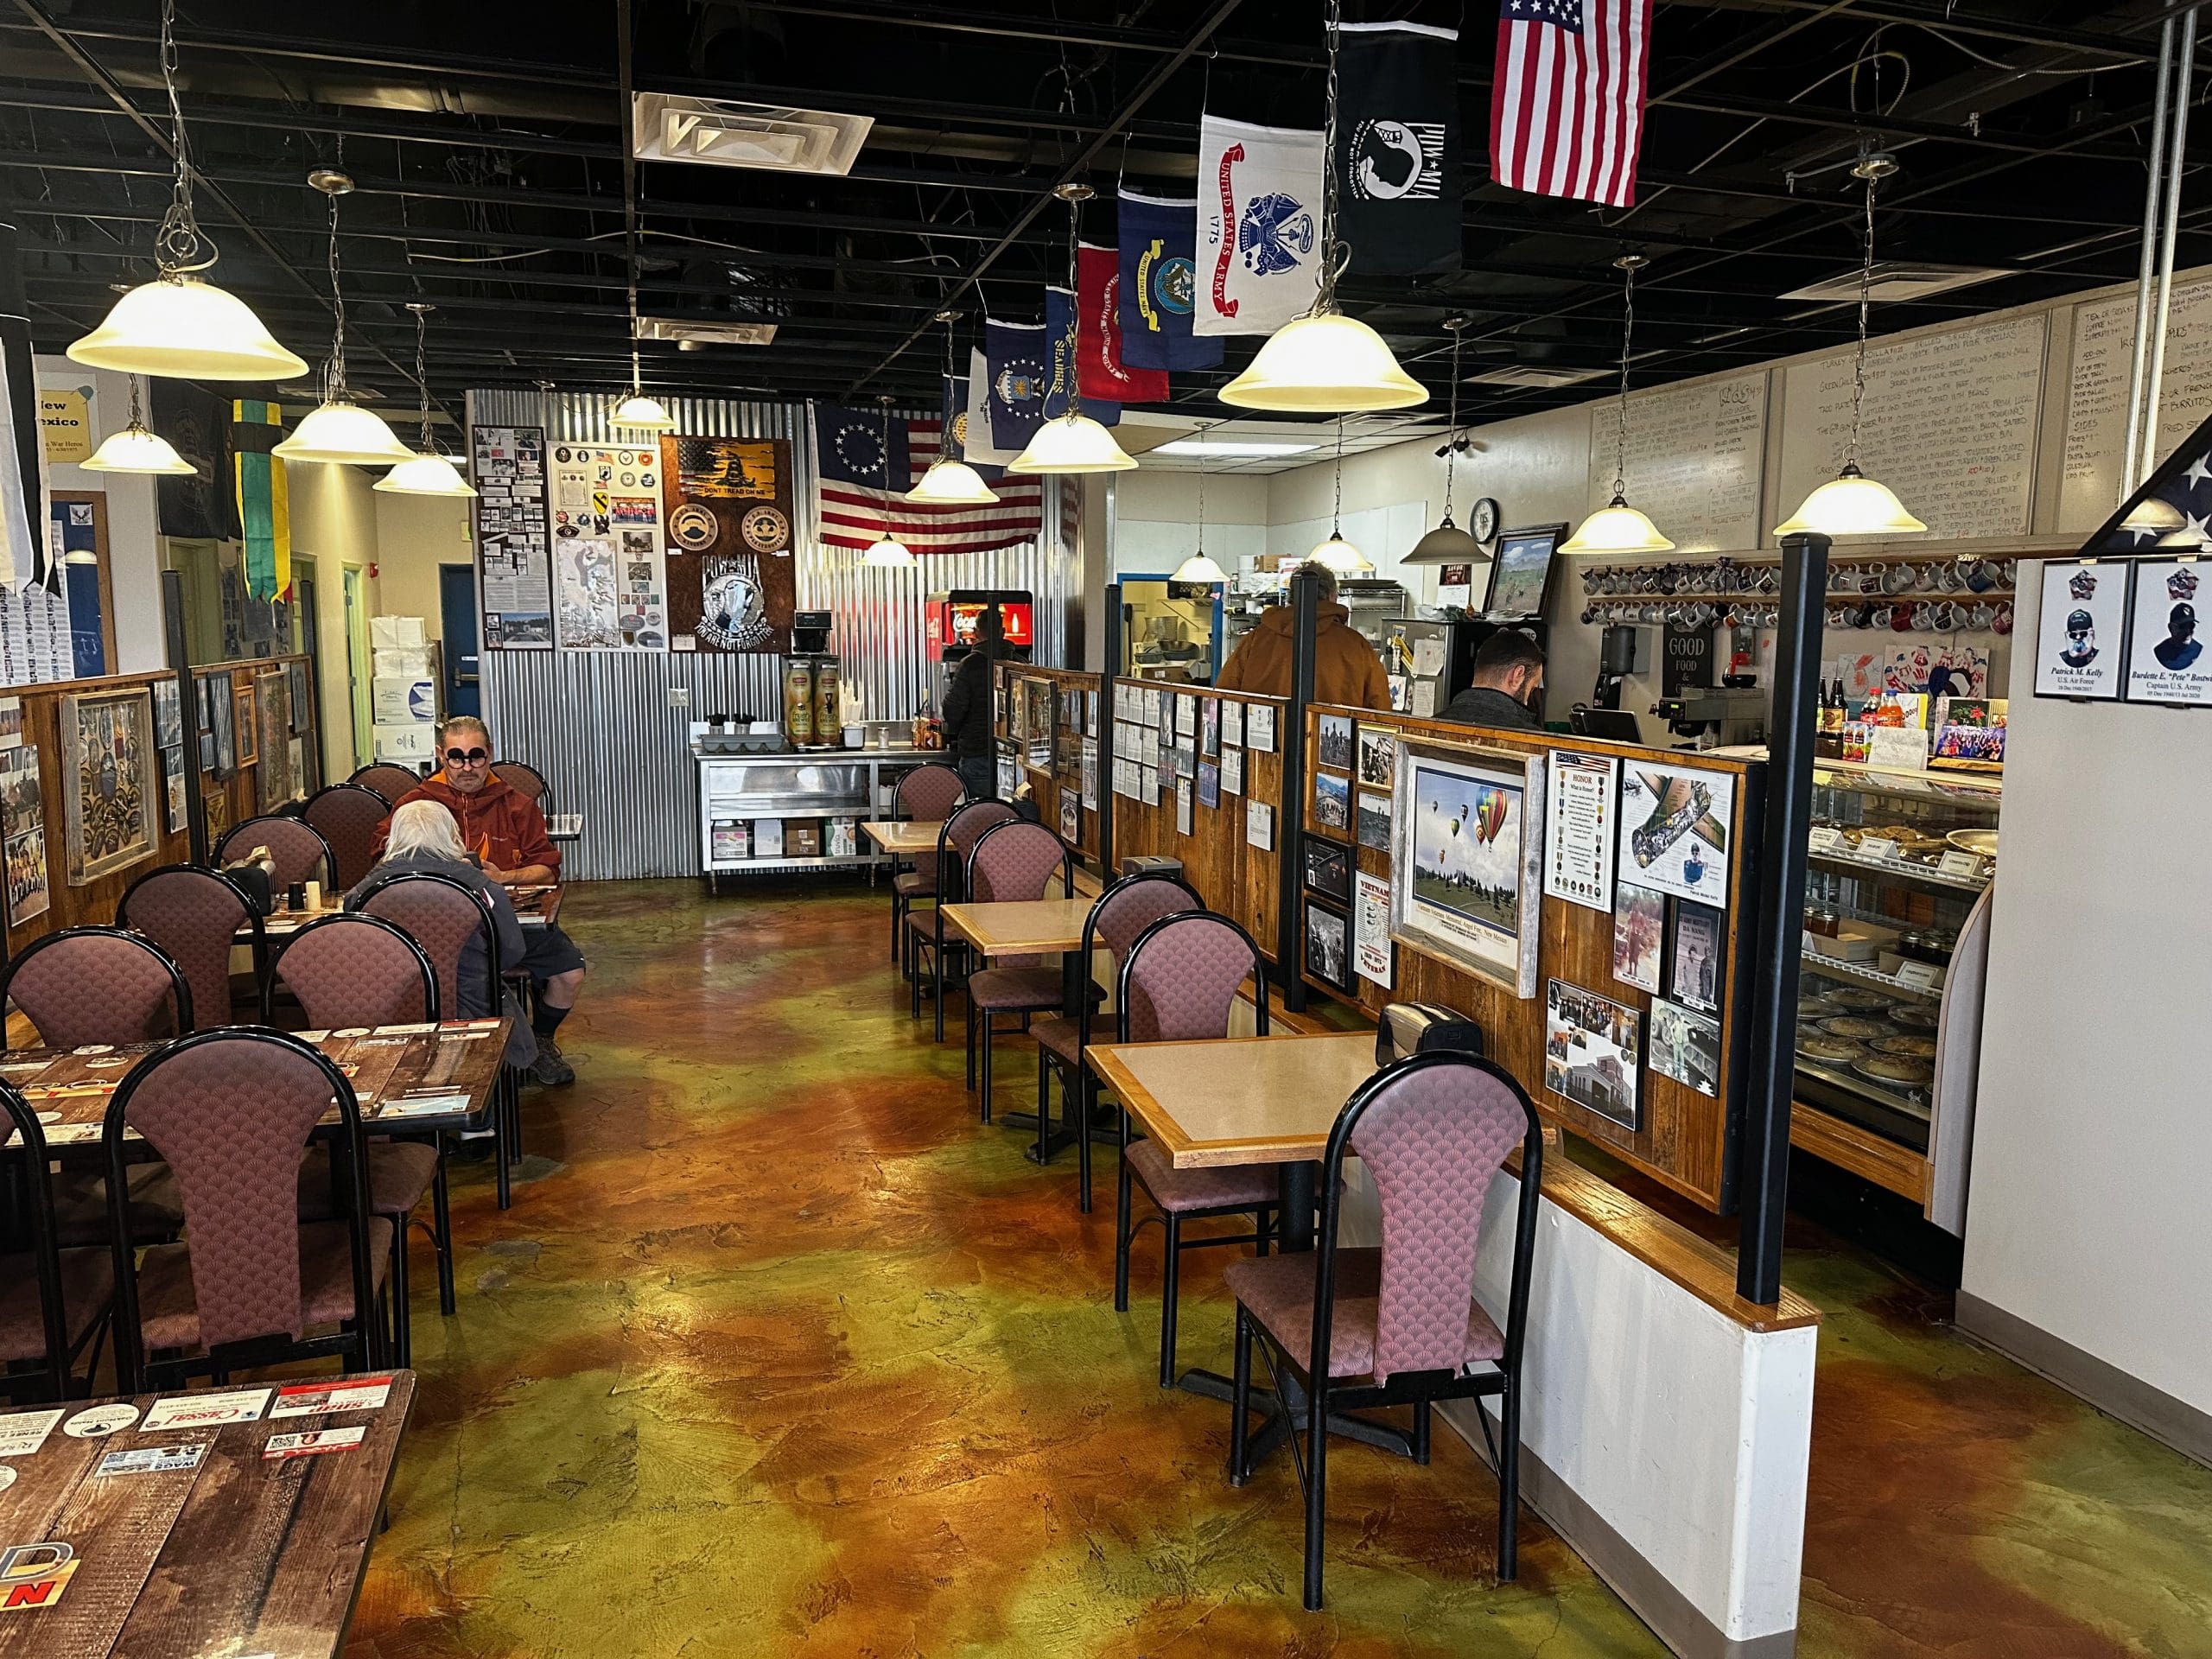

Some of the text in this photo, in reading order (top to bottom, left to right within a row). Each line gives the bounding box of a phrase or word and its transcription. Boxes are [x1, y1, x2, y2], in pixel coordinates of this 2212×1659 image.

[1357, 120, 1365, 132] YOU
[1399, 124, 1446, 199] POW MIA
[1349, 162, 1359, 200] FORGOTTEN
[1209, 216, 1219, 245] 1775
[1213, 162, 1234, 302] UNITED STATES ARMY
[1140, 255, 1151, 276] UNITED
[41, 416, 79, 426] exico
[2074, 418, 2098, 431] SIDES
[694, 622, 775, 651] YOU ARE NOT FORGOTTEN
[1669, 638, 1705, 656] GOOD
[1675, 659, 1697, 671] FOOD
[1681, 672, 1689, 681] &
[2051, 667, 2103, 678] Patrick M. Kelly
[2132, 671, 2158, 680] Burdette
[2146, 682, 2169, 690] Captain
[2184, 683, 2202, 692] Army
[1573, 773, 1592, 785] HONOR
[1360, 880, 1389, 897] VIETNAM
[1360, 953, 1386, 973] VETERAN
[155, 1461, 194, 1470] WAGS
